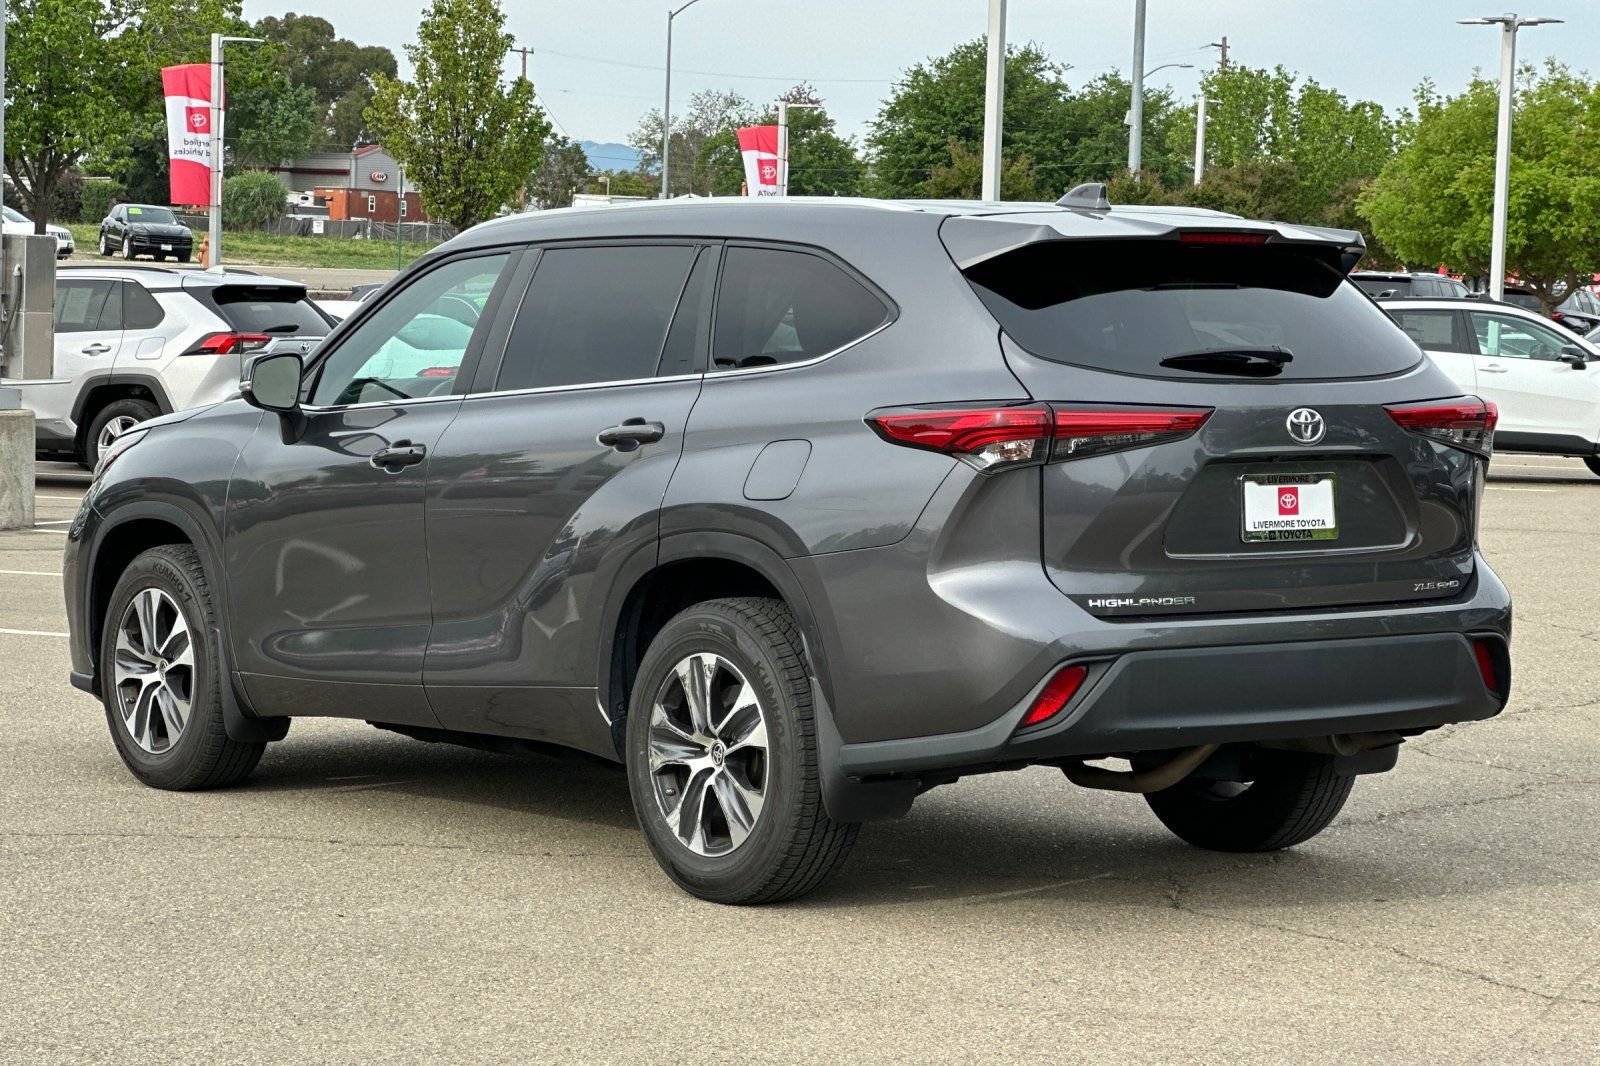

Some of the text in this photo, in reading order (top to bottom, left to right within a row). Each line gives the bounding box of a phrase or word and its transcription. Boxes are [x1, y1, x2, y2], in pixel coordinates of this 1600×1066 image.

[1267, 475, 1310, 484] LIVERMORE
[1253, 519, 1326, 529] LIVERMORE TOYOTA
[1279, 530, 1313, 539] TOYOTA
[152, 562, 184, 593] KUMHO
[1414, 582, 1436, 592] XLE
[1088, 596, 1196, 608] HIGHLANDER
[754, 661, 785, 738] KUMHO
